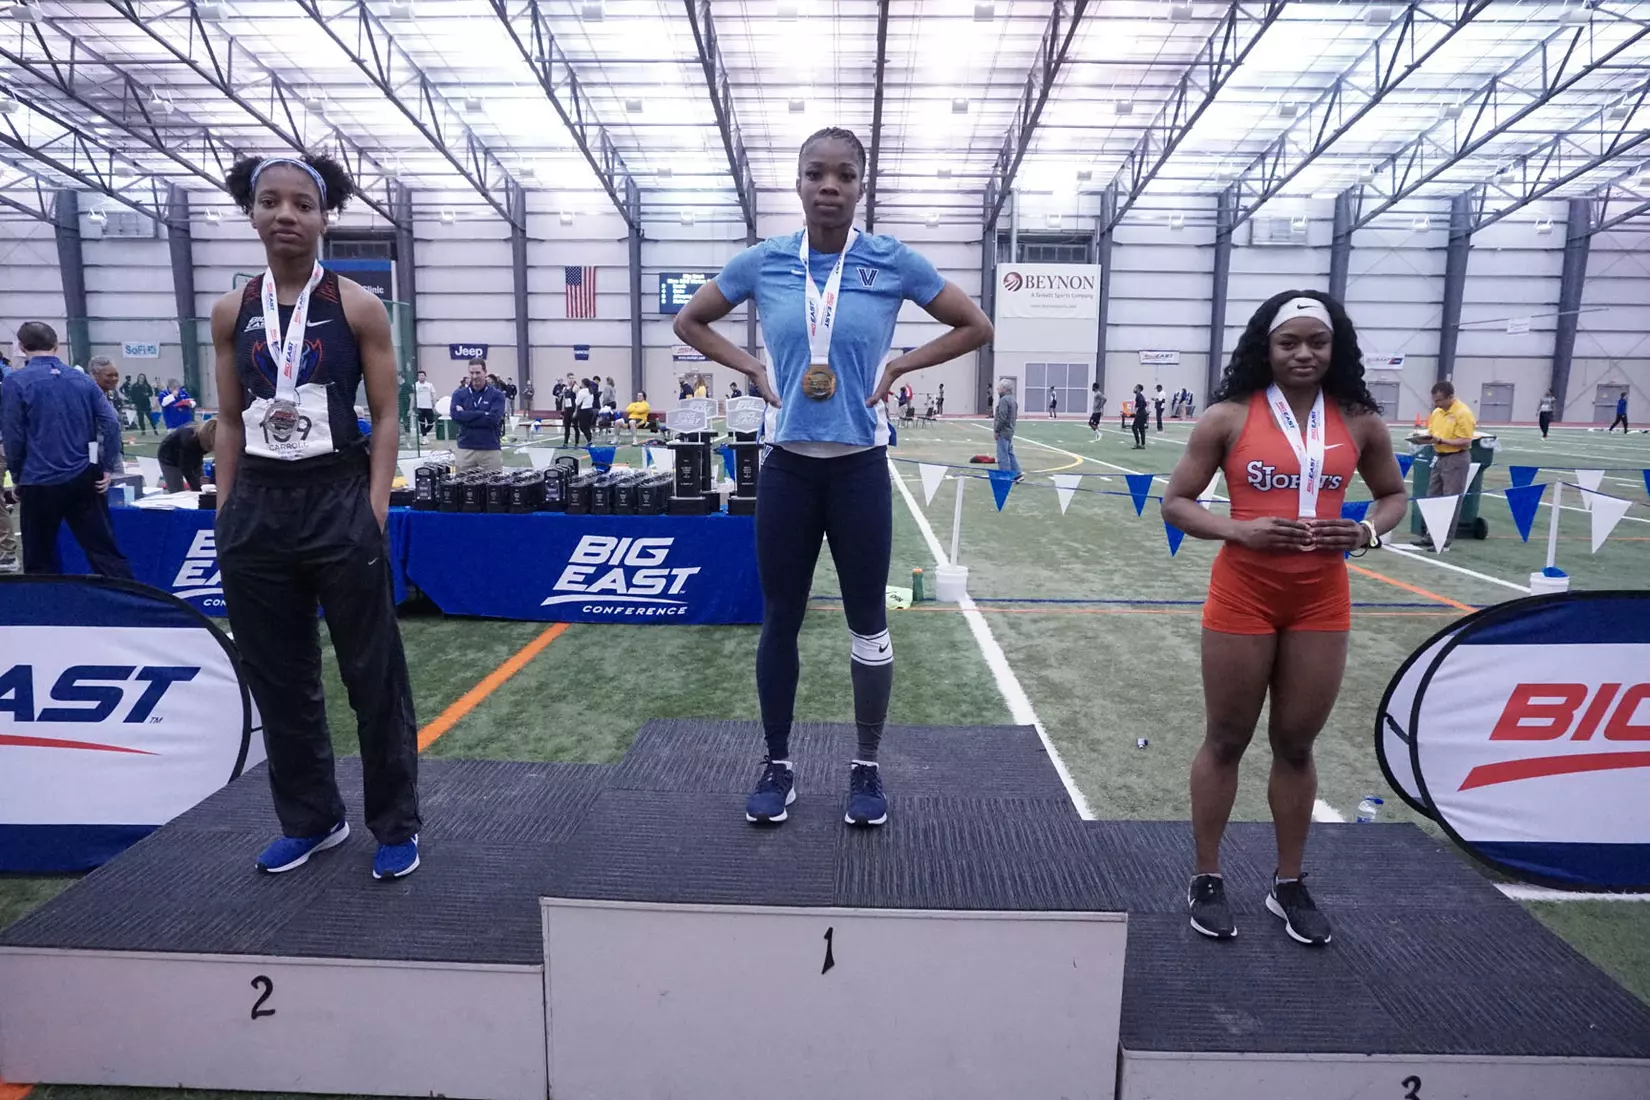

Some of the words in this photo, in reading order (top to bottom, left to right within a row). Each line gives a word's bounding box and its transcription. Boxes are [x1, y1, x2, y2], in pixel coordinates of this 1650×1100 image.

[857, 267, 879, 287] V
[1024, 275, 1095, 290] BEYNON
[824, 306, 833, 328] EAST
[125, 344, 146, 355] SoFi
[286, 341, 294, 363] EAST
[454, 345, 483, 358] Jeep
[1283, 412, 1295, 429] EAST
[1308, 458, 1317, 479] EAST
[568, 534, 675, 567] BIG
[552, 564, 702, 595] EAST
[582, 605, 688, 616] CONFERENCE
[821, 926, 835, 975] 1
[251, 975, 276, 1020] 2
